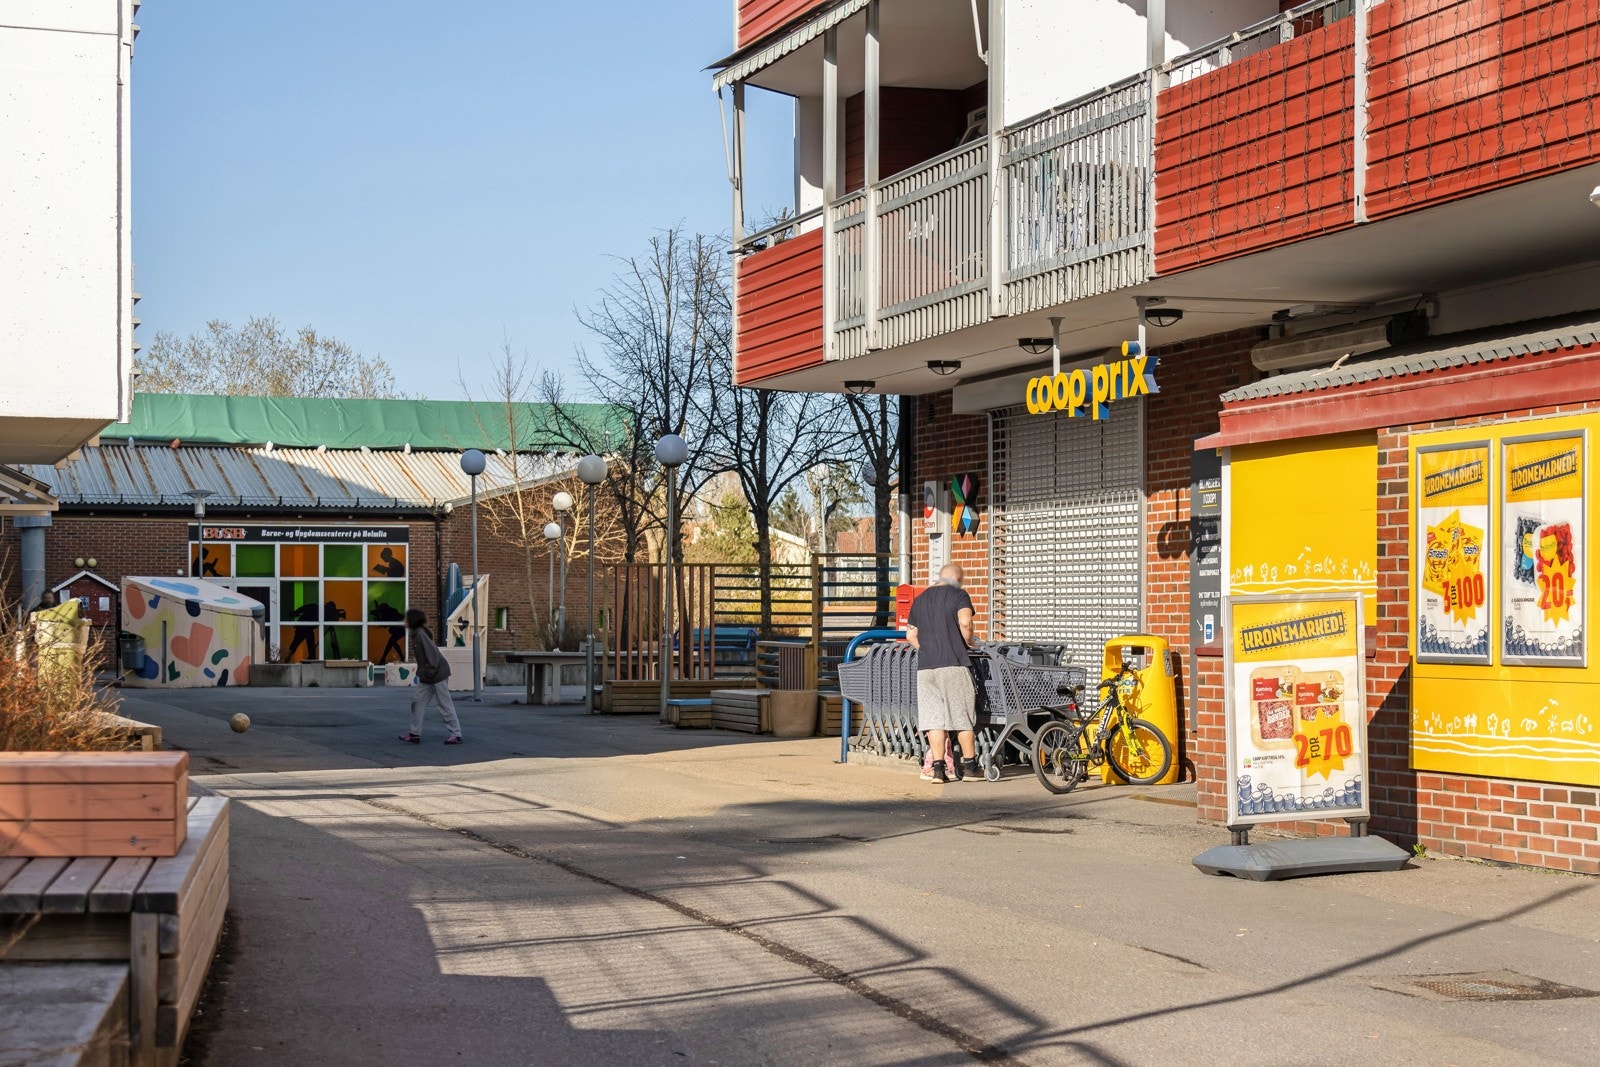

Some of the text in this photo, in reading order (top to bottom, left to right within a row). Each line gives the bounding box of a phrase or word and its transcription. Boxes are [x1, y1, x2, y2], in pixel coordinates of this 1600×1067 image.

[1026, 340, 1150, 420] coop prix
[1425, 463, 1482, 494] KRONEMARKED!
[1512, 454, 1577, 490] KRONEMARKED!
[203, 527, 246, 539] BUSH
[261, 529, 284, 537] Barne-
[1442, 581, 1451, 613] 3
[1456, 573, 1485, 609] 100
[1243, 614, 1344, 650] KRONEMARKED!
[1294, 725, 1352, 767] 2 FOR 70
